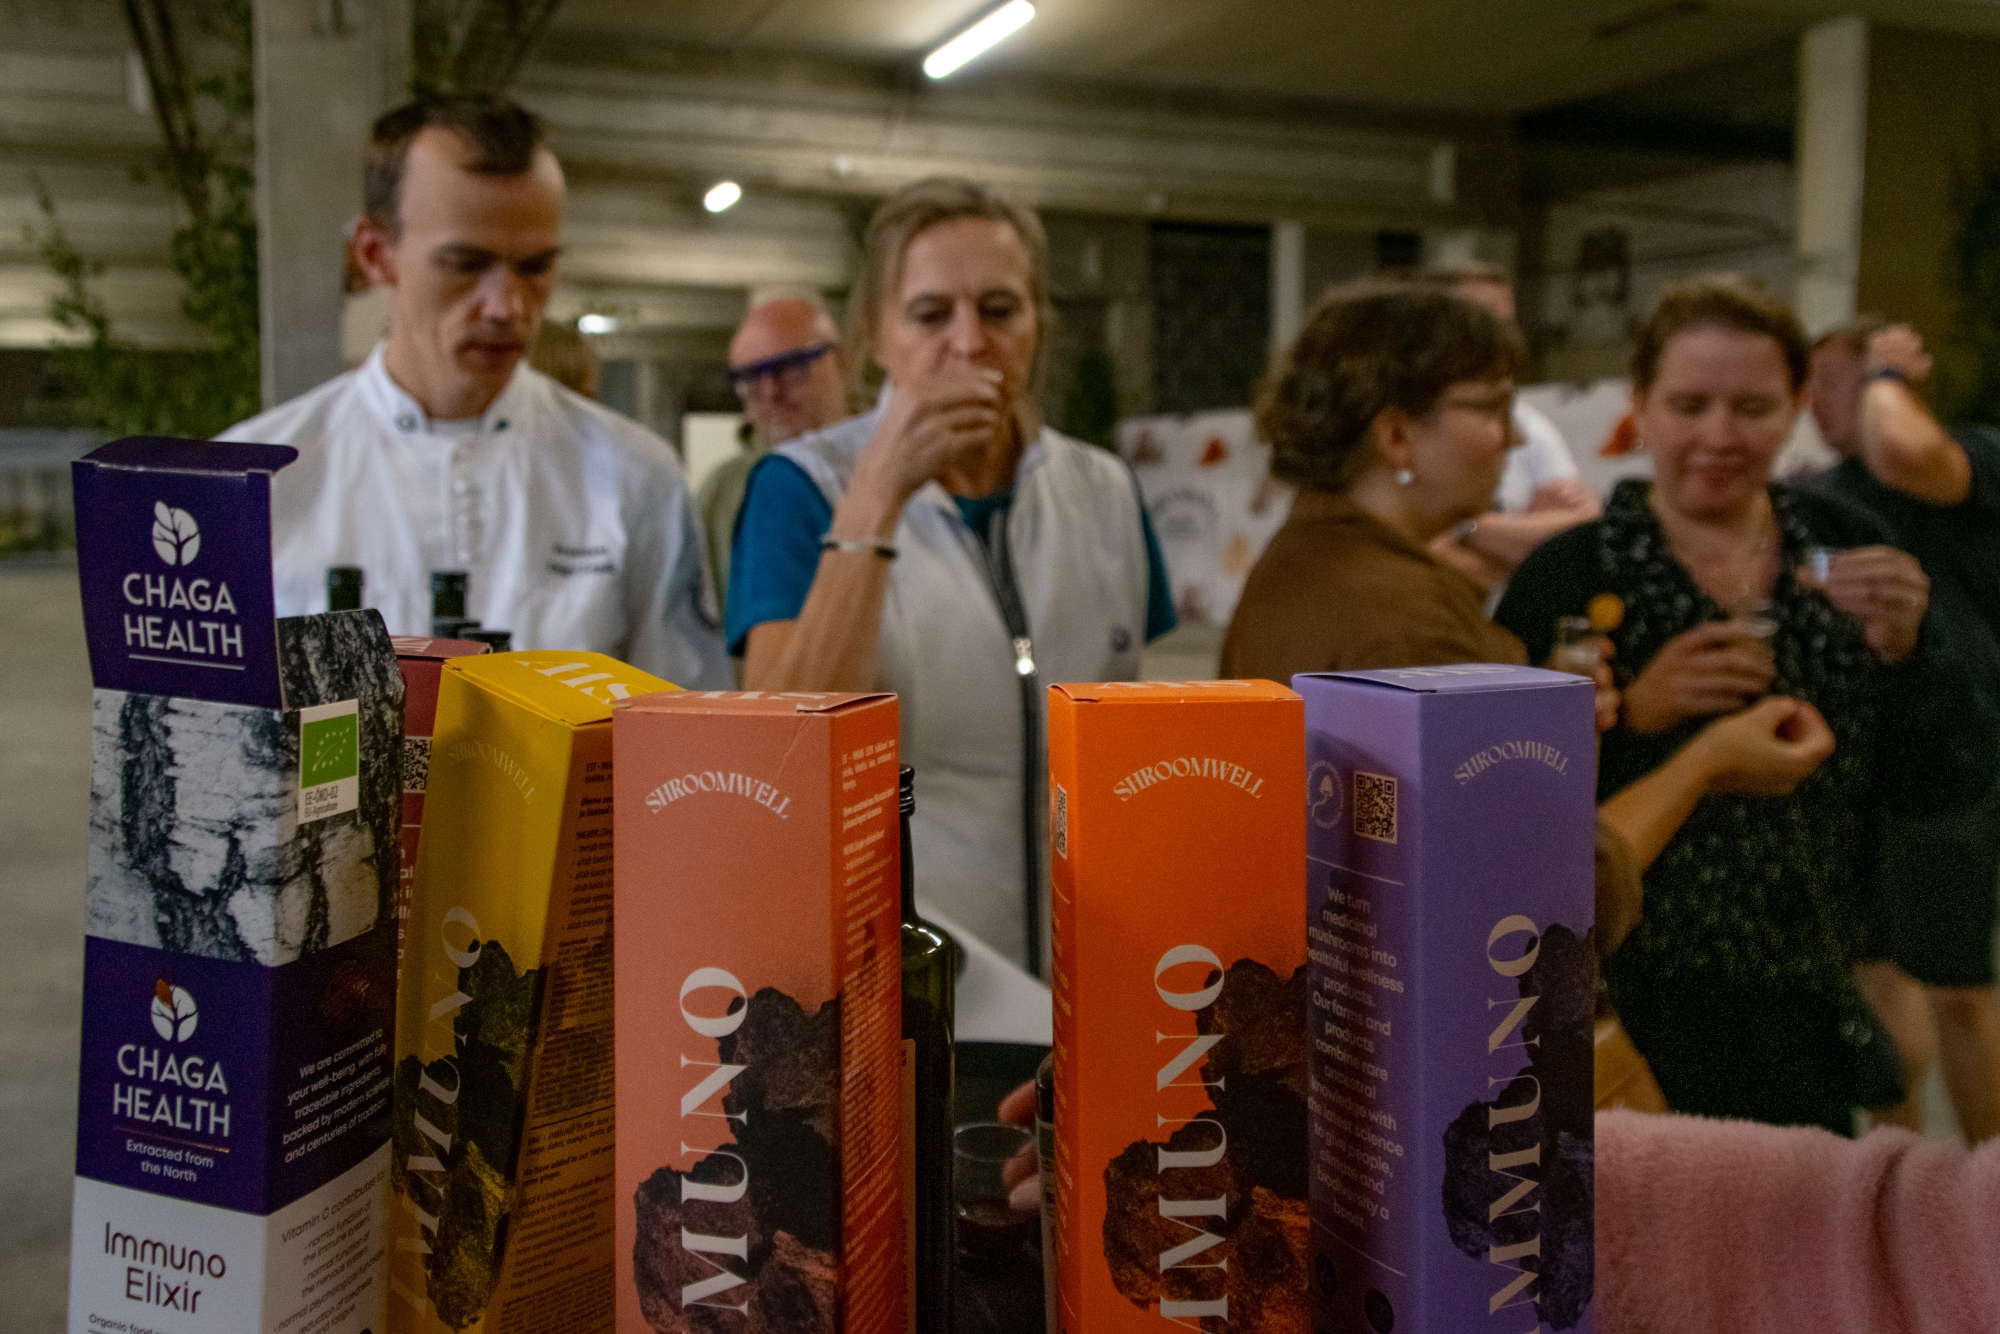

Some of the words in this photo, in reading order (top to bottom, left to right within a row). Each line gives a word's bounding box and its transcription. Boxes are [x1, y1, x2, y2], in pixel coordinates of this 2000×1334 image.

[122, 573, 237, 615] CHAGA
[123, 613, 243, 657] HEALTH
[1113, 757, 1265, 802] SHROOMWELL
[1453, 740, 1568, 787] SHROOMWELL
[645, 770, 792, 820] SHROOMWELL
[1327, 885, 1346, 905] We
[1347, 894, 1371, 913] turn
[1322, 909, 1378, 939] medicinal
[1308, 926, 1370, 959] mushrooms
[1371, 945, 1398, 968] into
[1350, 965, 1405, 994] wellness
[1313, 991, 1333, 1011] Our
[1332, 999, 1364, 1025] farms
[1365, 1016, 1391, 1037] and
[300, 1064, 316, 1079] We
[316, 1056, 332, 1071] are
[333, 1031, 375, 1063] committed
[1324, 1021, 1375, 1053] products
[116, 1043, 229, 1095] CHAGA
[287, 1085, 311, 1107] your
[358, 1051, 375, 1068] with
[1315, 1038, 1360, 1069] combine
[1362, 1061, 1389, 1082] rare
[113, 1083, 231, 1138] HEALTH
[282, 1116, 320, 1145] backed
[320, 1112, 333, 1126] by
[333, 1094, 365, 1119] modern
[365, 1076, 390, 1100] science
[295, 1089, 340, 1120] traceable
[1367, 1108, 1398, 1132] with
[1487, 914, 1541, 1334] MMUNO
[126, 1138, 182, 1161] Extracted
[184, 1150, 214, 1168] from
[284, 1143, 306, 1164] and
[306, 1123, 348, 1152] centuries
[348, 1114, 358, 1129] of
[1354, 1124, 1405, 1157] science
[140, 1159, 161, 1175] the
[163, 1165, 198, 1182] North
[1359, 1173, 1385, 1196] and
[281, 1213, 321, 1243] Vitamin
[321, 1207, 330, 1221] C
[330, 1177, 376, 1215] contributes
[308, 1229, 334, 1248] normal
[336, 1206, 364, 1231] function
[364, 1199, 371, 1213] of
[1379, 1206, 1390, 1221] a
[104, 1221, 227, 1280] Immuno
[302, 1252, 316, 1266] the
[317, 1235, 347, 1257] immune
[306, 1258, 334, 1282] normal
[334, 1238, 361, 1263] function
[125, 1266, 203, 1314] Elixir
[278, 1305, 308, 1331] normal
[309, 1271, 359, 1313] psychological
[301, 1284, 316, 1298] the
[316, 1264, 345, 1289] nervous
[89, 1313, 128, 1332] Organic
